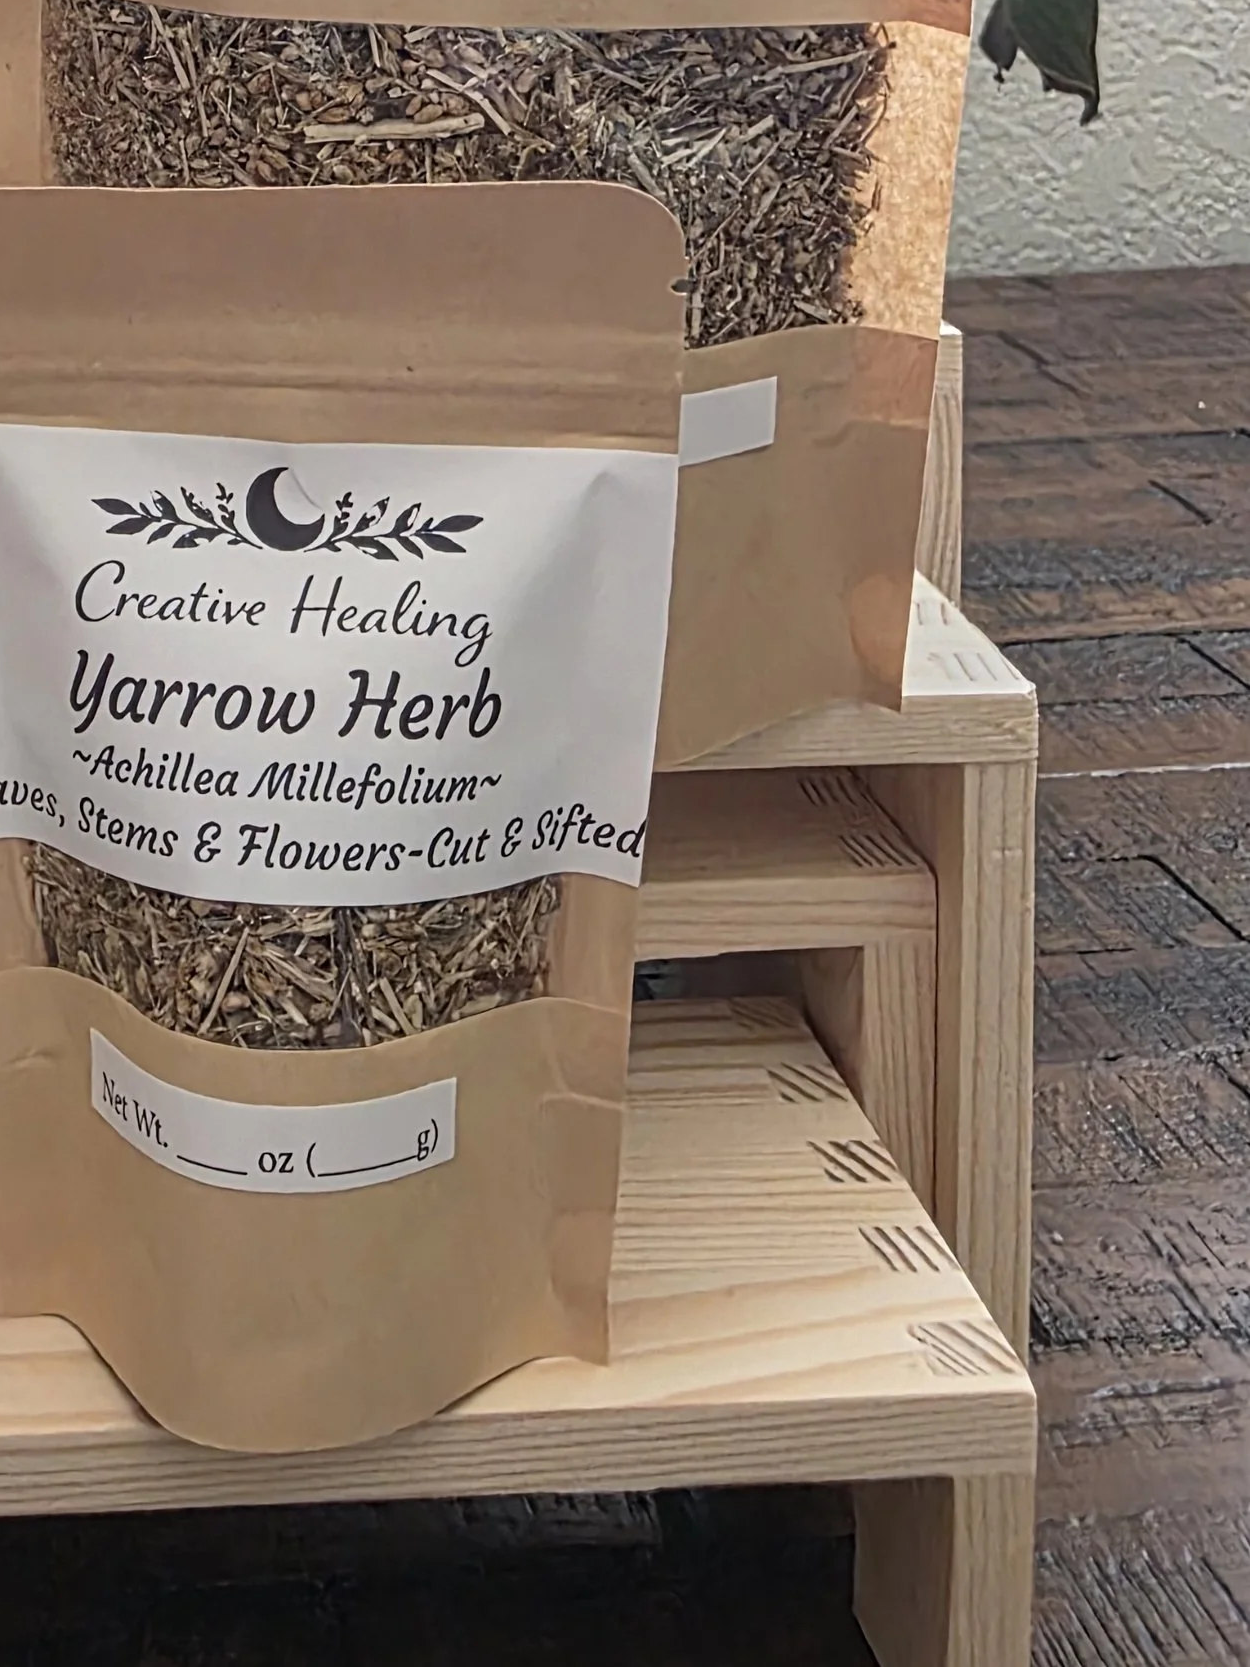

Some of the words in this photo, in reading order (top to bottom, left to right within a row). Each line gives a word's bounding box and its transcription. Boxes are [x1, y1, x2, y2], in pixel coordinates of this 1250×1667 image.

[76, 560, 265, 626] Creative
[290, 575, 493, 667] Healing
[70, 650, 315, 734] Yarrow
[338, 667, 501, 740] Herb
[78, 797, 178, 857] Stems
[194, 821, 221, 863] &
[238, 823, 490, 871] Flowers-Cut
[501, 817, 523, 857] &
[532, 803, 646, 858] Sifted
[103, 1071, 127, 1121] Net
[133, 1099, 168, 1148] Wt.
[258, 1152, 294, 1173] oz
